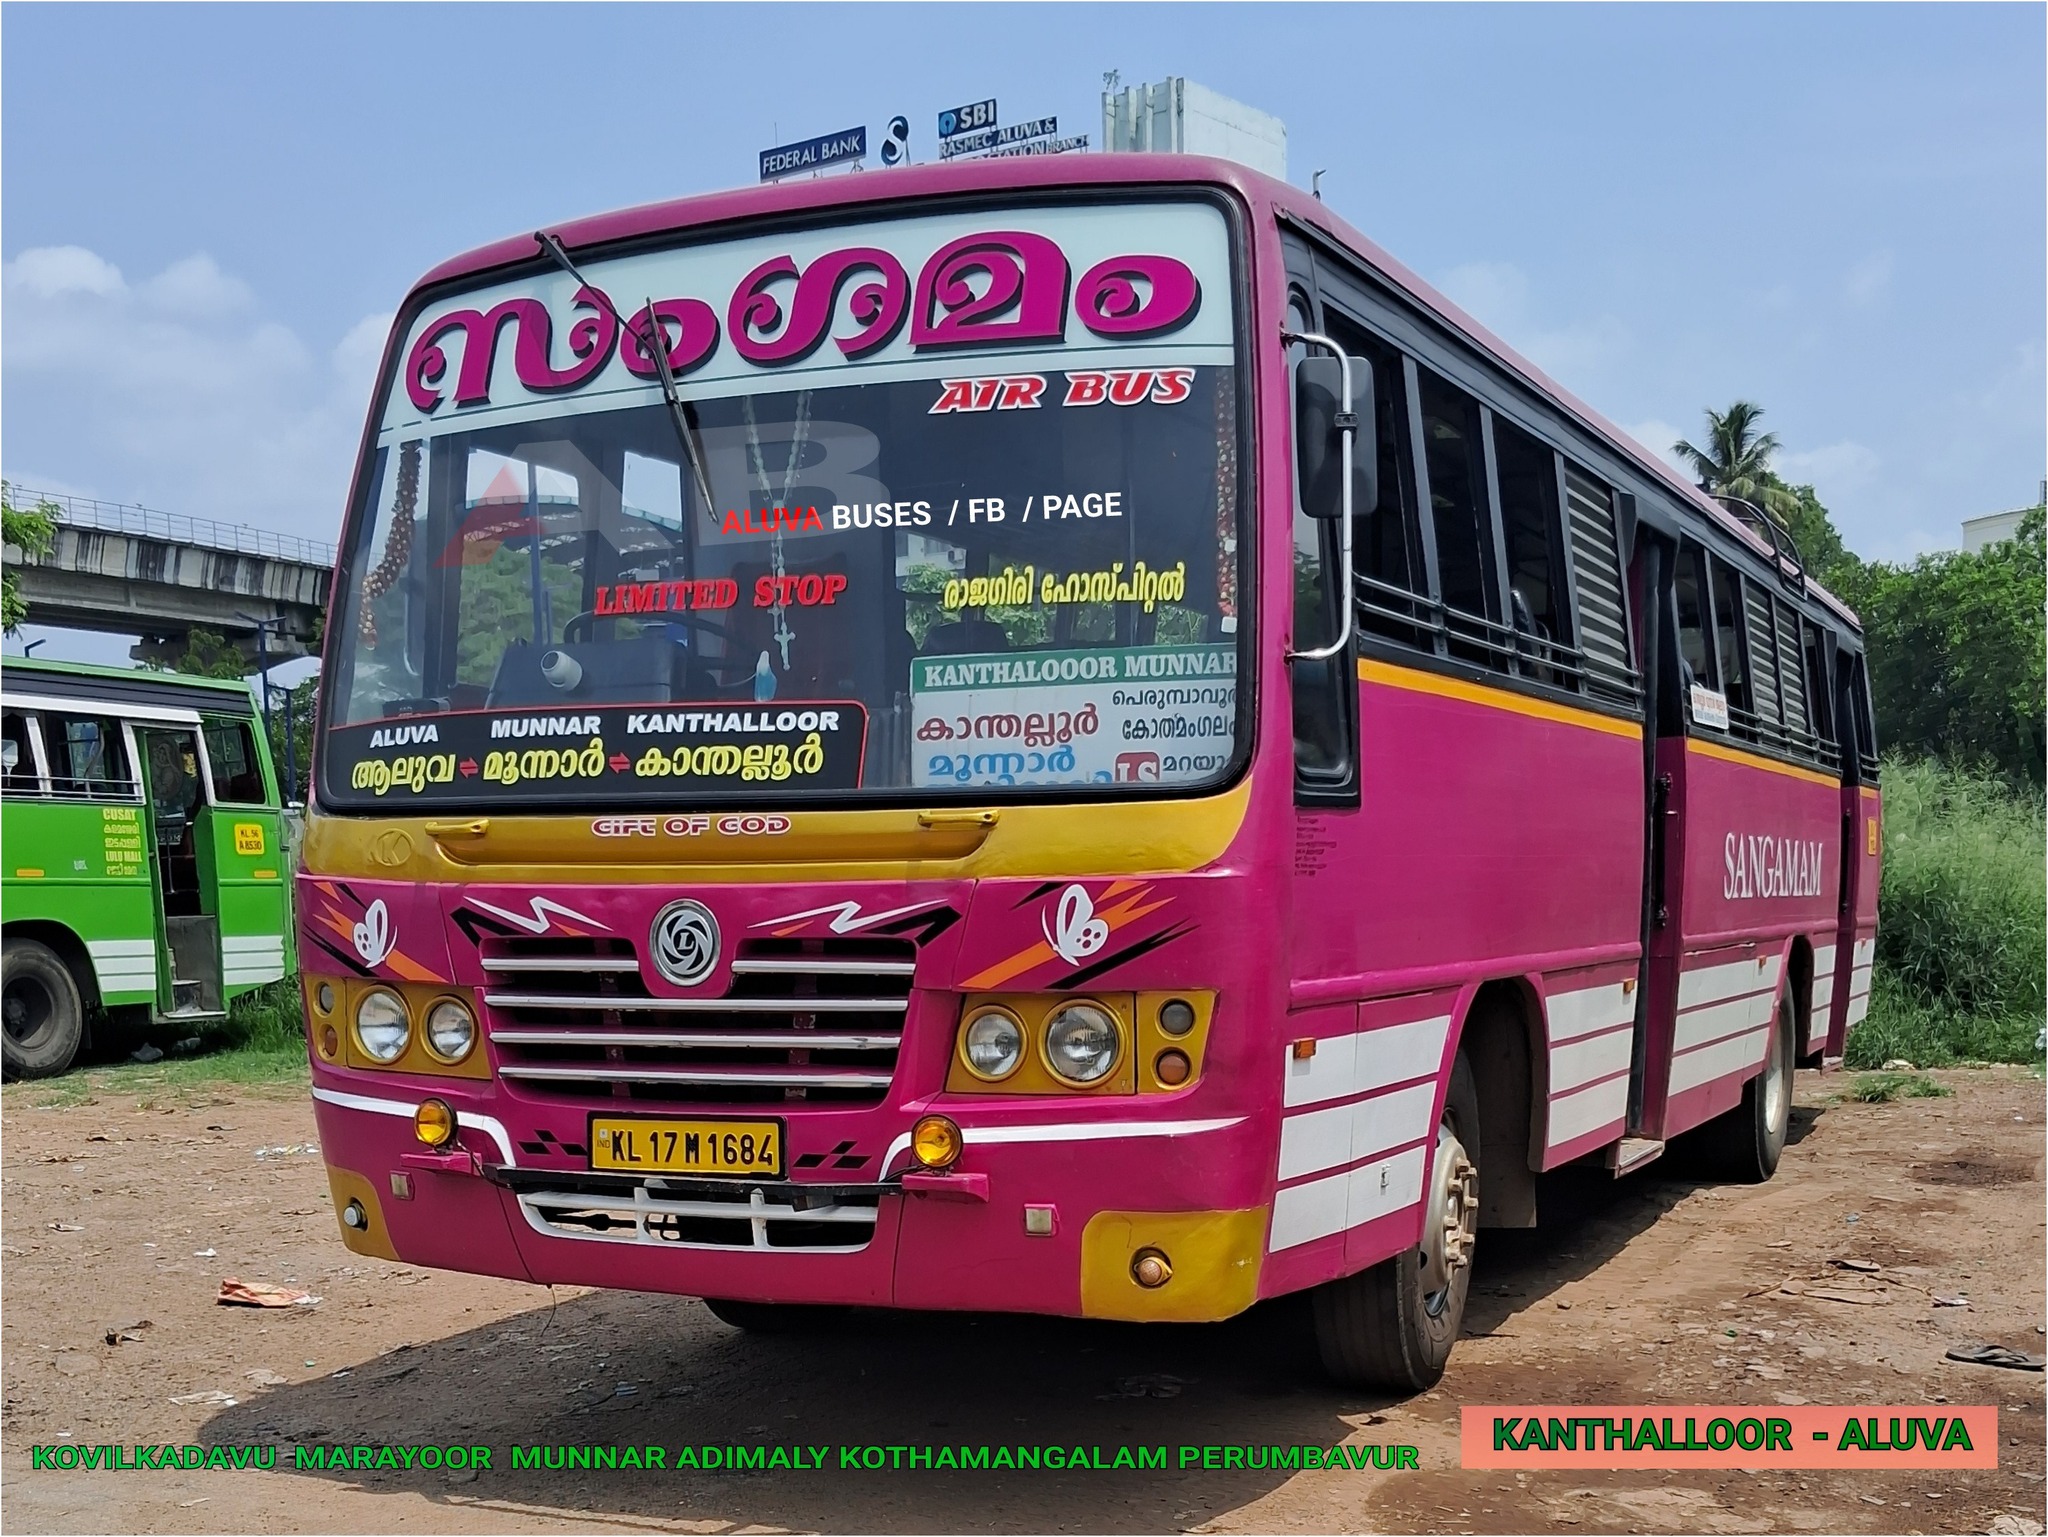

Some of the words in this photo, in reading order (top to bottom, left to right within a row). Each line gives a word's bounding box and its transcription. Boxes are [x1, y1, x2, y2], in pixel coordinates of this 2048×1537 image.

[959, 101, 995, 130] SBI
[996, 121, 1043, 145] ALUVA
[1044, 118, 1055, 133] &
[763, 146, 818, 175] FEDERAL
[821, 135, 861, 161] BANK
[404, 229, 1201, 414] സംഗമം
[927, 373, 1048, 414] AIR
[1062, 368, 1196, 406] BUS
[594, 578, 739, 616] LIMITED
[753, 574, 848, 609] STOP
[944, 565, 1035, 609] രാജഗിരി
[924, 656, 1117, 688] KANTHALOOOR
[370, 725, 438, 748] ALUVA
[490, 716, 601, 738] MUNNAR
[627, 711, 839, 734] KANTHALLOOR
[916, 703, 1100, 747] കാന്തല്ലൂർ
[351, 753, 456, 795] ആലുവ
[483, 738, 605, 785] മൂന്നാർ
[635, 732, 825, 782] കാന്തല്ലൂർ
[928, 744, 1076, 782] മൂന്നാർ
[102, 808, 137, 821] CUSAT
[663, 817, 710, 836] OF
[717, 816, 792, 835] GOD
[1723, 832, 1823, 900] SANGAMAM
[677, 932, 695, 951] L
[597, 1139, 611, 1149] IND
[612, 1130, 642, 1163] KL
[649, 1131, 678, 1163] 17
[684, 1132, 700, 1164] M
[707, 1133, 773, 1166] 1684
